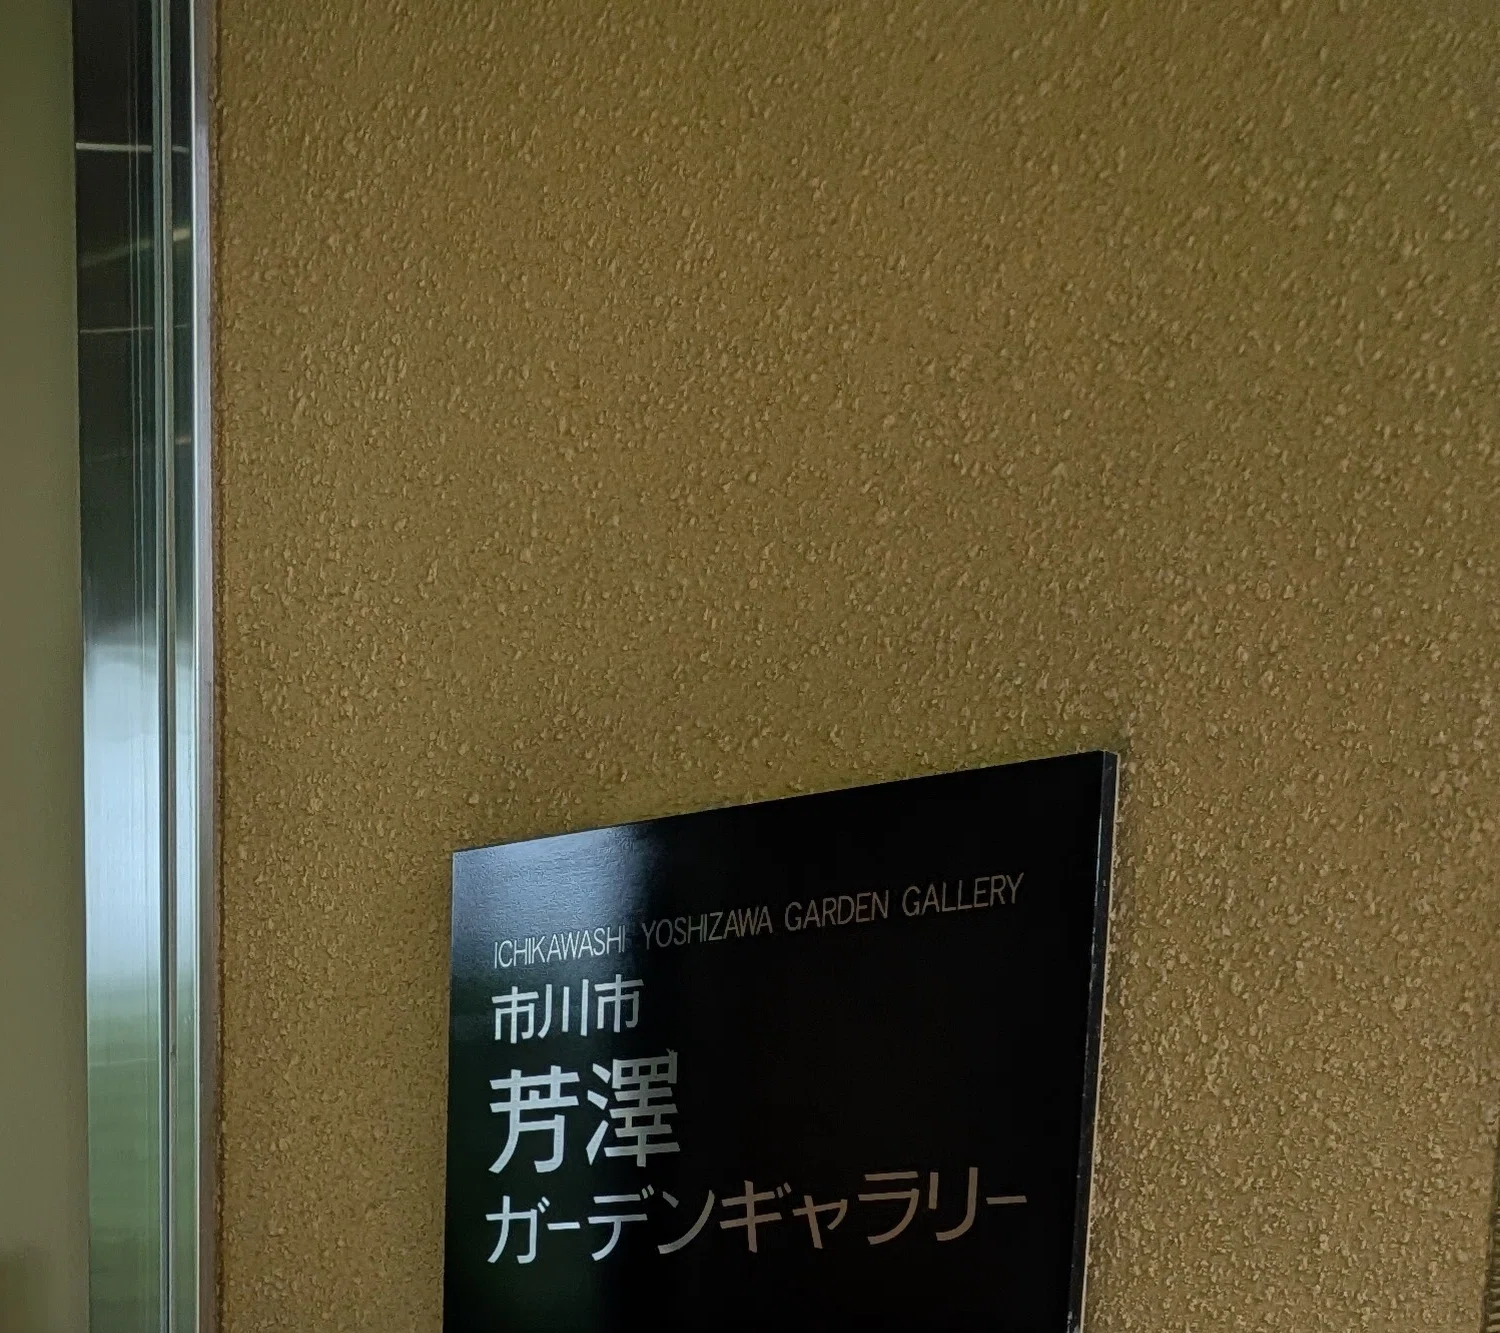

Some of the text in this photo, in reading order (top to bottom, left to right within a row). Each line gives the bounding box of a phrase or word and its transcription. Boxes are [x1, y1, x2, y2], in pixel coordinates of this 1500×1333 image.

[493, 872, 1025, 969] ICHIKAWASHI YOSHIZAWA GARDEN GALLERY
[491, 974, 644, 1044] 市川市
[488, 1049, 680, 1174] 芳澤
[486, 1166, 1027, 1264] ガーデンギャラリー
